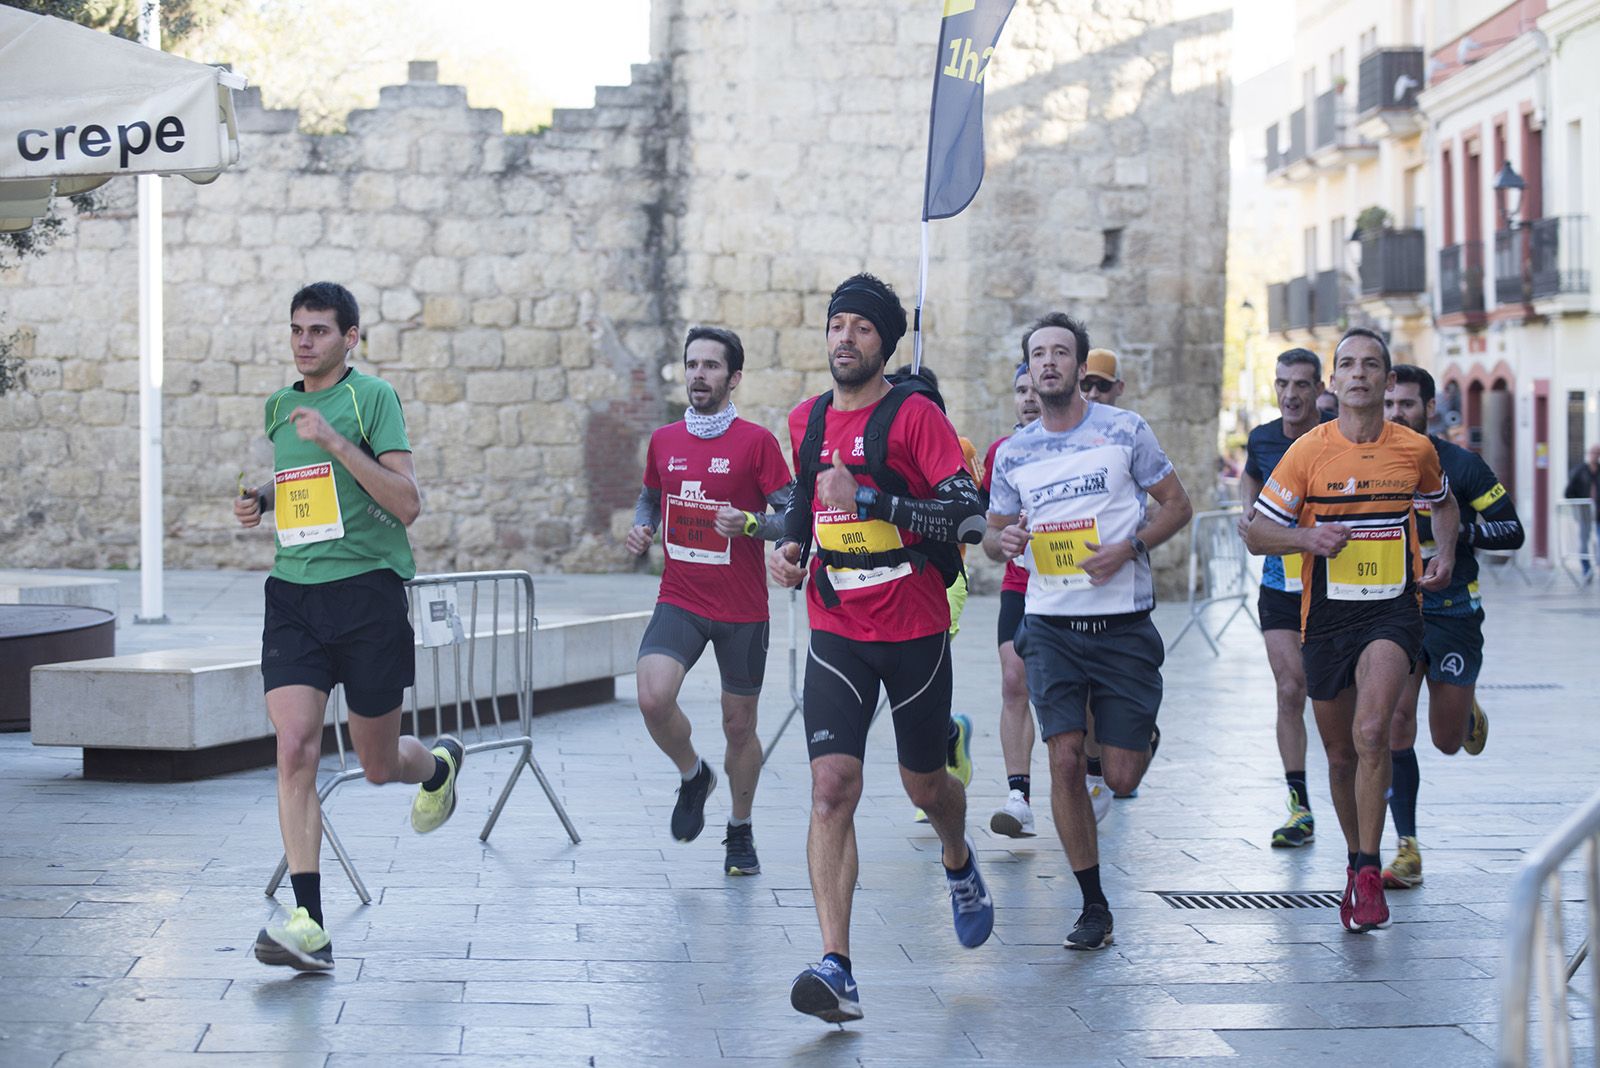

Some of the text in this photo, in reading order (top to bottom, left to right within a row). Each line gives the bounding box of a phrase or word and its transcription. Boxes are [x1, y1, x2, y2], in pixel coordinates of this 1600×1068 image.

[17, 116, 185, 168] crepe
[285, 470, 299, 479] SANT
[300, 469, 319, 477] CUGAT
[1327, 482, 1344, 491] PRO
[289, 488, 309, 501] SERGI
[293, 502, 310, 518] 782
[699, 503, 718, 511] CUGAT
[688, 530, 703, 543] 641
[841, 532, 866, 545] ORIOL
[1056, 553, 1075, 568] 848
[1357, 562, 1378, 577] 970
